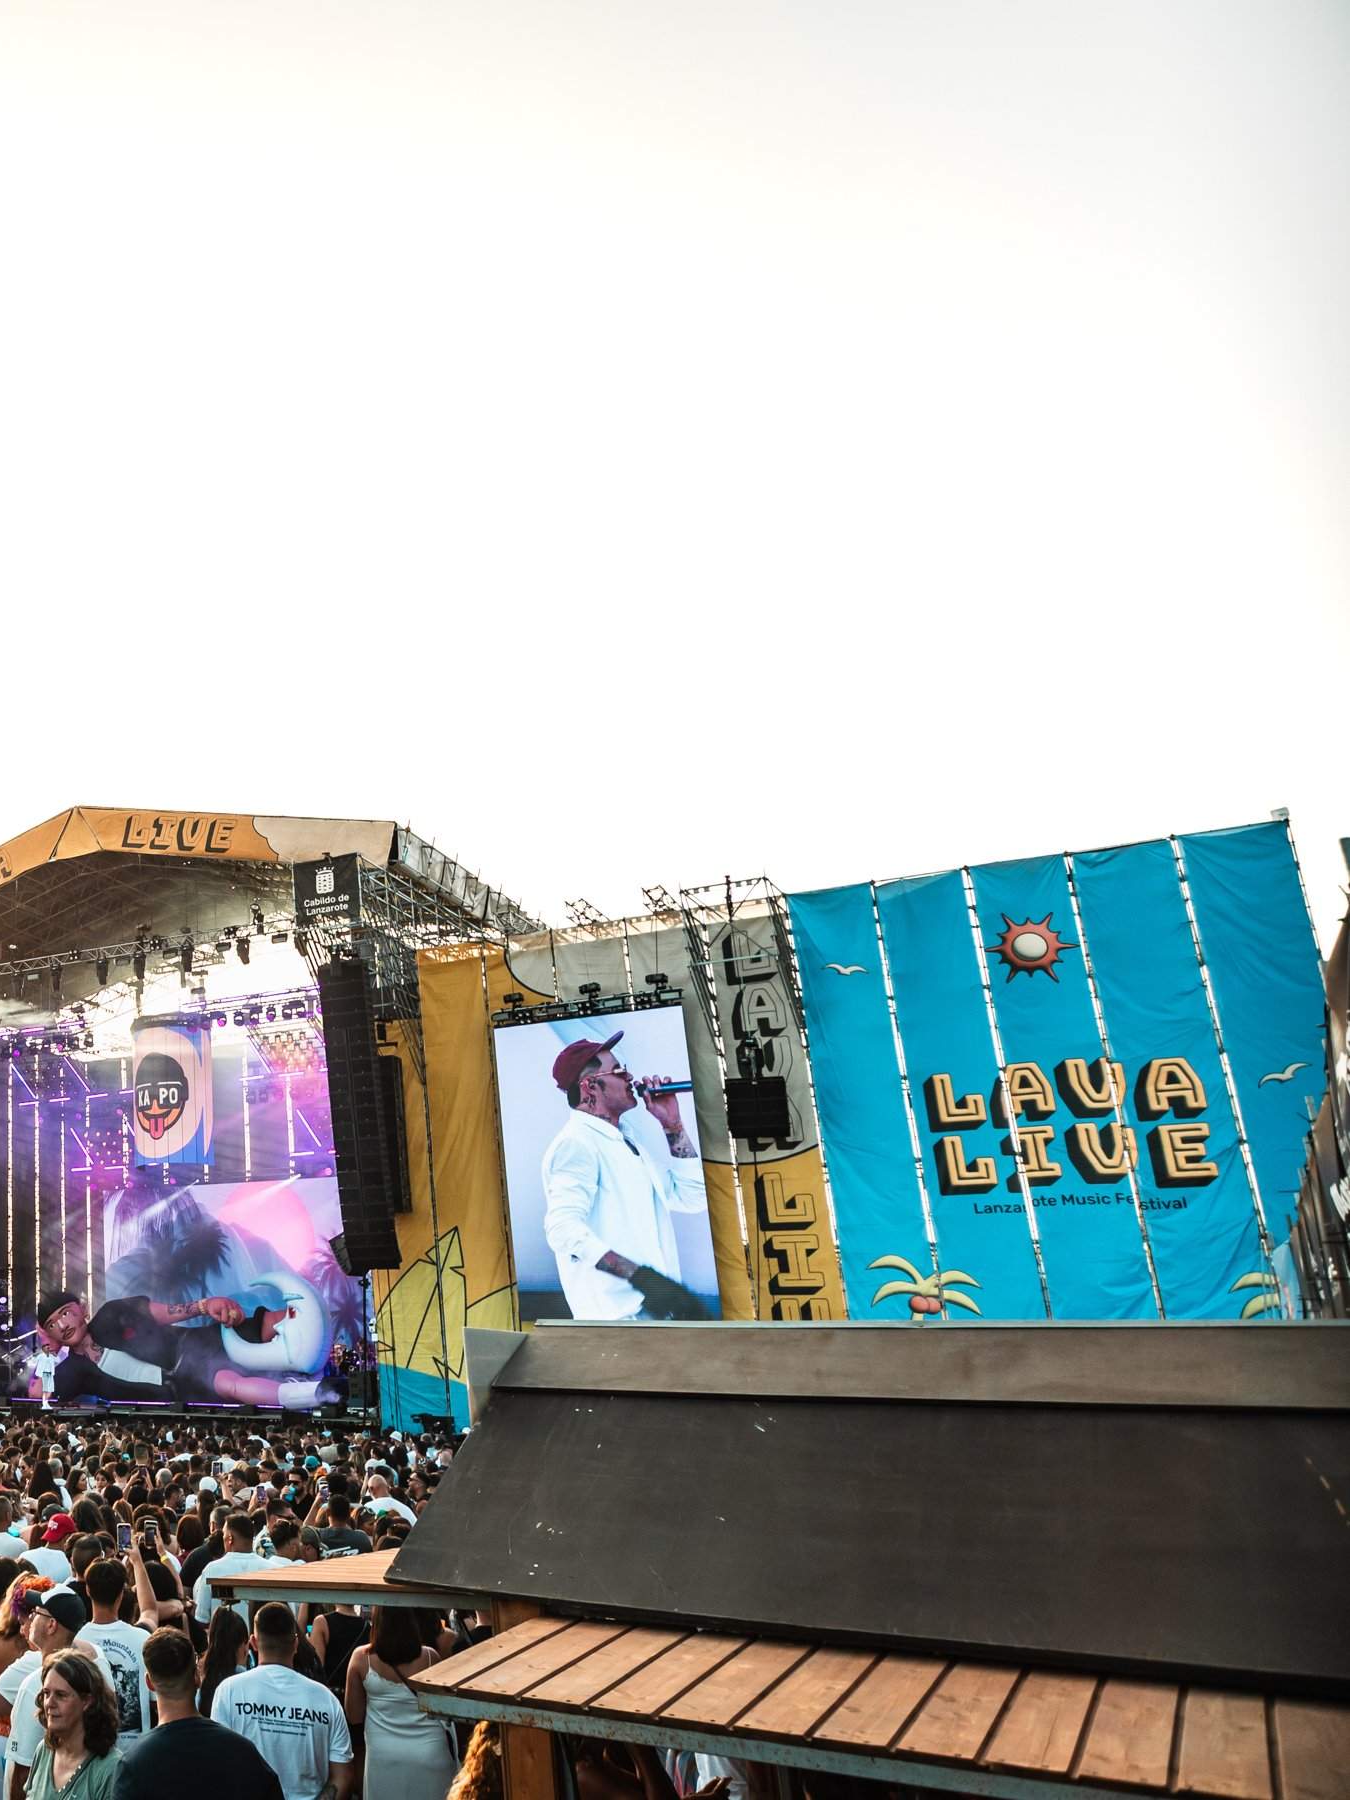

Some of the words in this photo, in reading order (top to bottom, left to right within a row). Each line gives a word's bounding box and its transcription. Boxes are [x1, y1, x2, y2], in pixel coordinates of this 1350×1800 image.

[121, 813, 238, 853] LIVE
[304, 896, 336, 908] Cabildo
[338, 894, 350, 902] de
[306, 903, 349, 916] Lanzarote
[923, 1057, 1207, 1132] LAVA
[933, 1122, 1219, 1196] LIVE
[1061, 1193, 1112, 1206] Music
[1115, 1192, 1188, 1210] Festival
[103, 1639, 137, 1663] Mountain
[235, 1702, 286, 1718] TOMMY
[288, 1707, 330, 1725] JEANS
